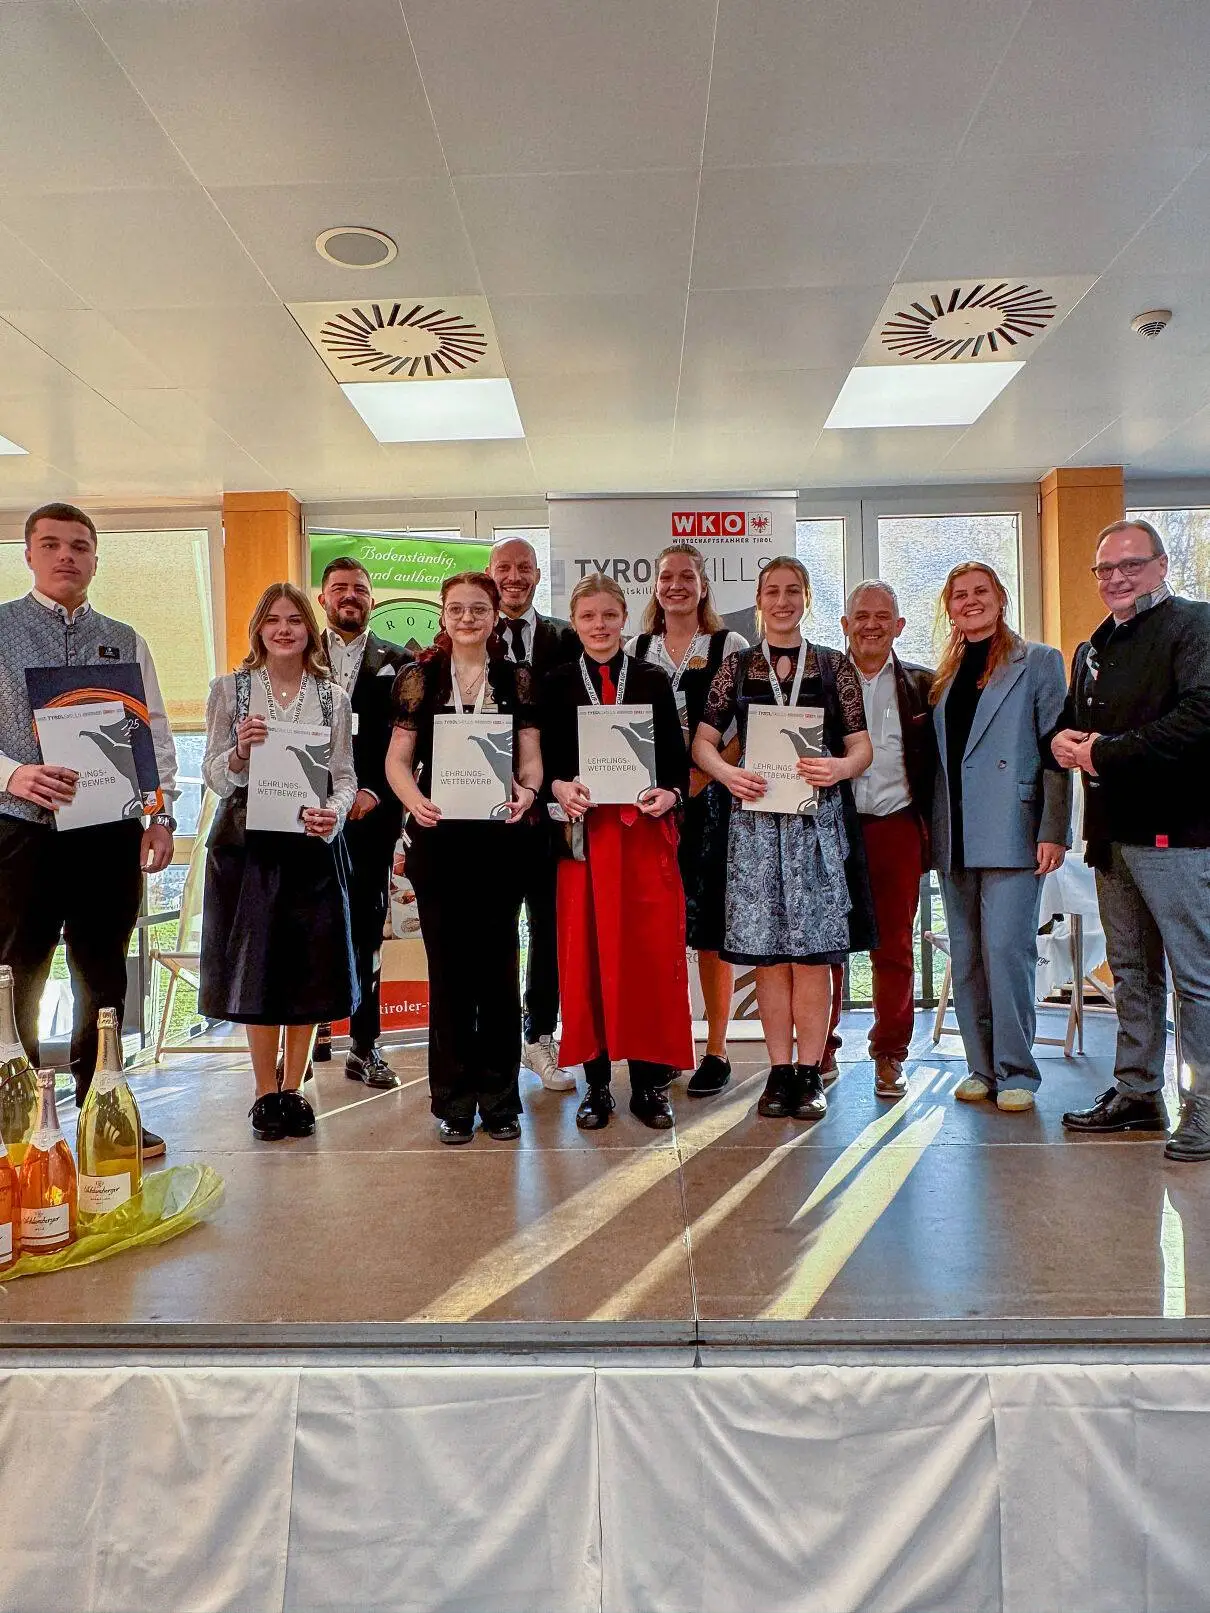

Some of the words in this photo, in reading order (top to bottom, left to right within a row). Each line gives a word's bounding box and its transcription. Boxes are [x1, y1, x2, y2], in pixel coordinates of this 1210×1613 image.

[673, 513, 744, 534] WKO
[360, 545, 457, 570] Bodenständig,
[394, 568, 449, 584] authent
[79, 769, 107, 779] LINGS-
[77, 776, 116, 788] TBEWERB
[258, 779, 300, 789] LEHRLINGS-
[257, 788, 308, 798] WETTBEWERB
[379, 1000, 429, 1015] tiroler-
